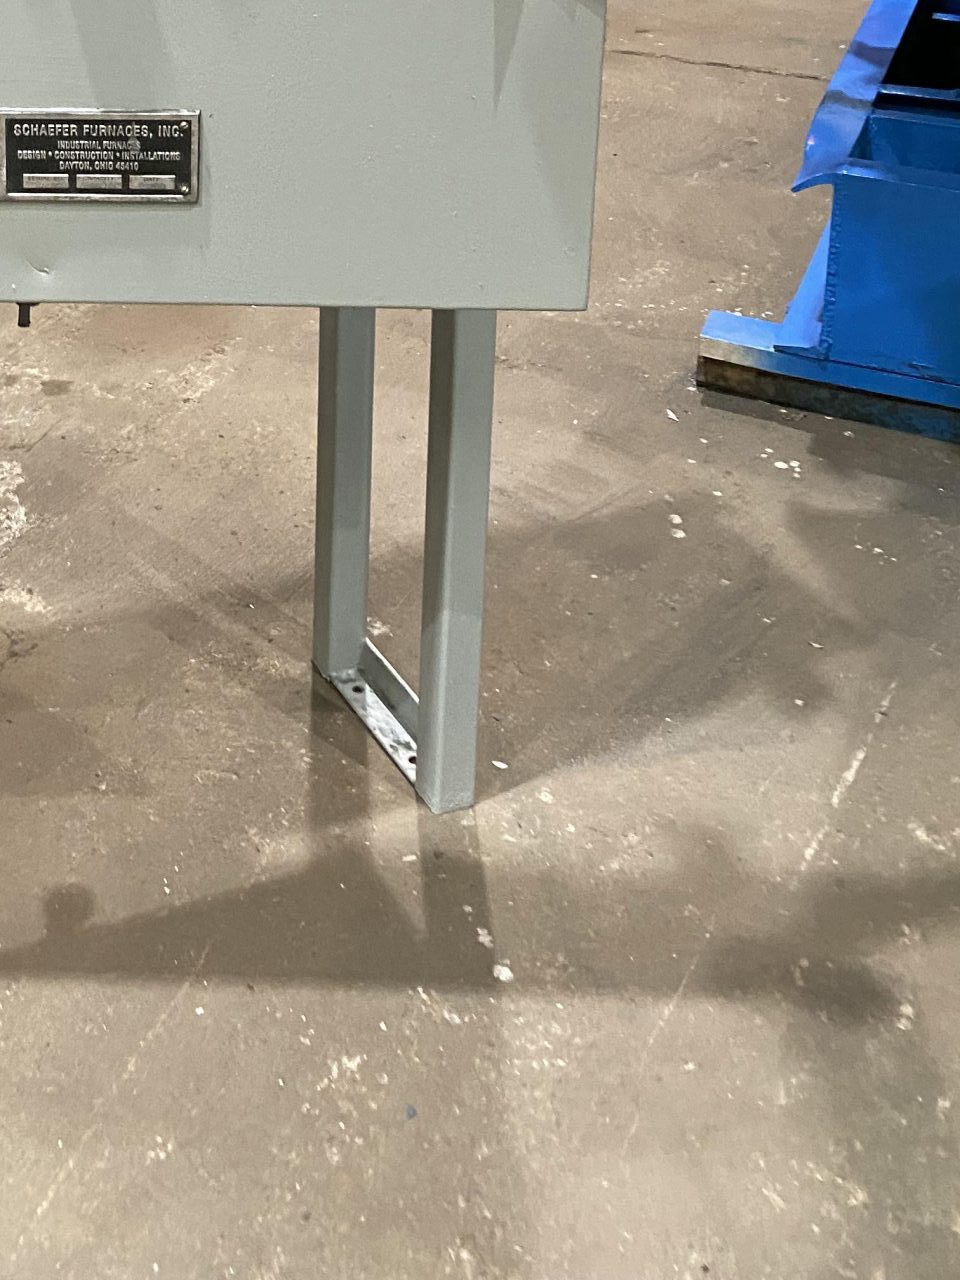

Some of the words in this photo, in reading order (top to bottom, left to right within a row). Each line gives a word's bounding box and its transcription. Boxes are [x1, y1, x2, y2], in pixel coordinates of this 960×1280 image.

[13, 124, 78, 137] SCHAEFER
[83, 124, 153, 138] FURNACES,
[158, 125, 184, 137] INC.
[57, 140, 101, 150] INDUSTRIAL
[17, 150, 46, 160] DESIGN
[54, 150, 114, 160] CONSTRUCTION
[121, 151, 181, 161] INSTALLATIONS
[94, 161, 113, 170] OHIO
[115, 161, 139, 171] 45410
